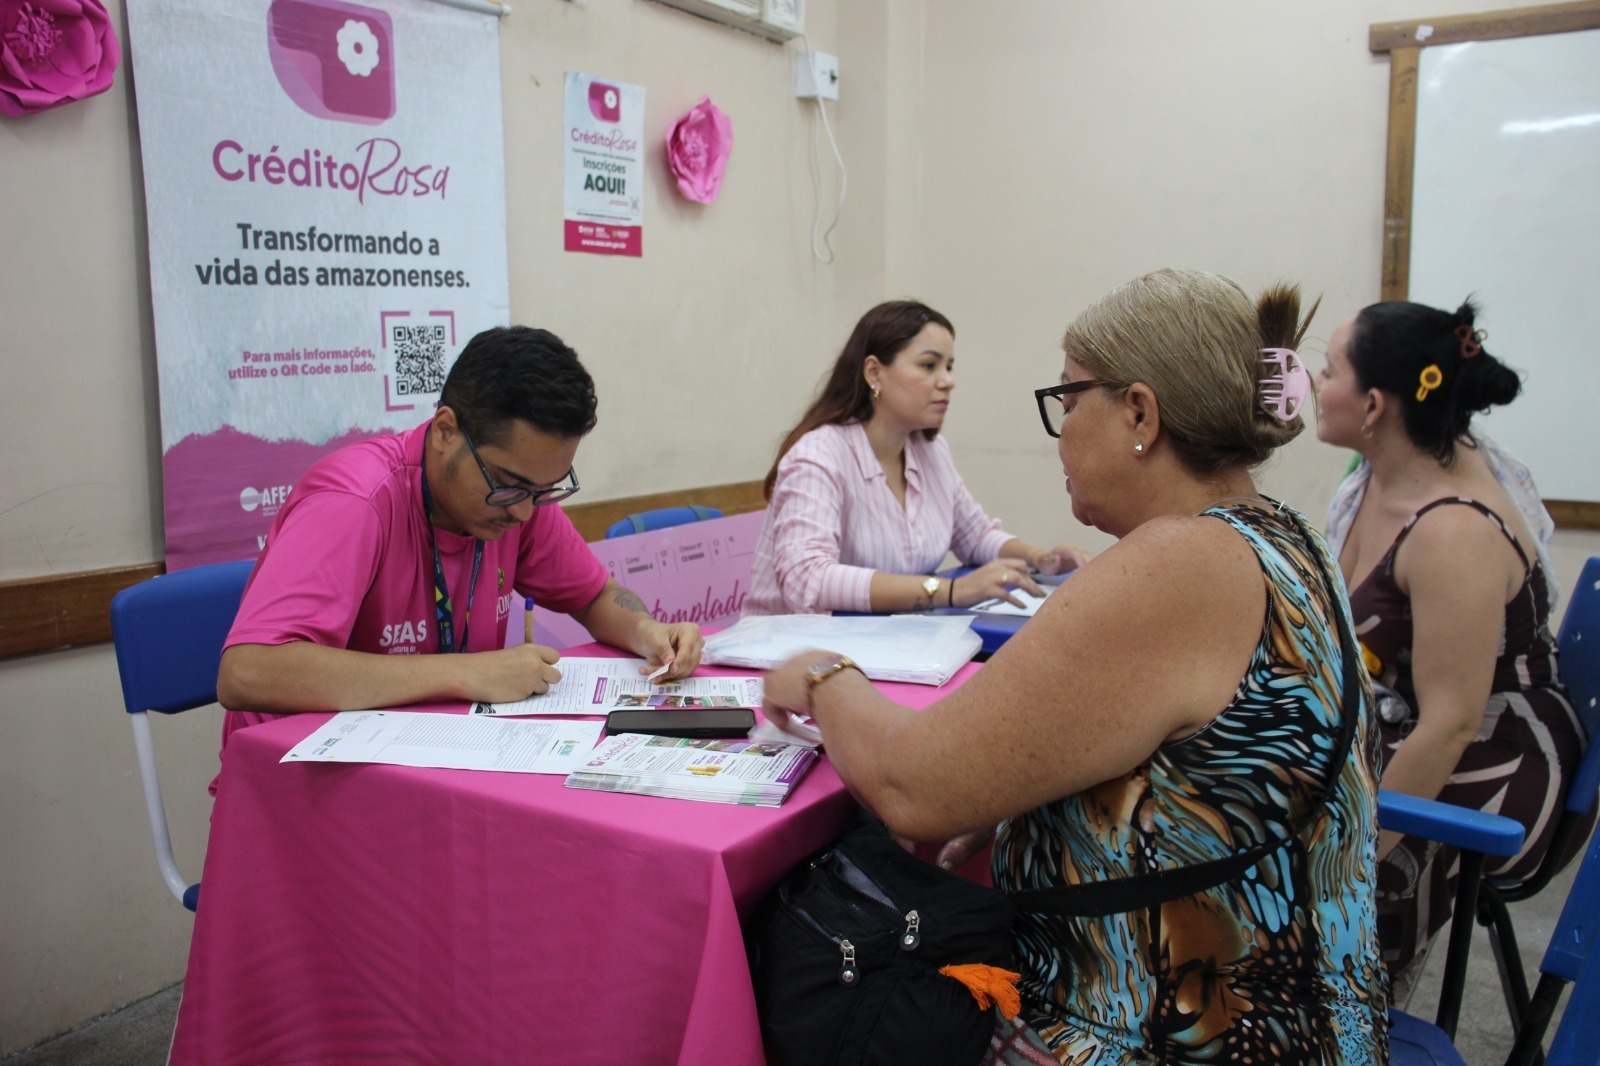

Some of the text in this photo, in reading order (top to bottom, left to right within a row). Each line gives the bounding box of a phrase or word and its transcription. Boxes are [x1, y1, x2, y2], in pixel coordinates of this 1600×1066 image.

[583, 157, 626, 177] Inscrições
[584, 173, 626, 195] AQUI!
[237, 223, 440, 256] Transformando a
[195, 258, 470, 288] vida das amazonenses.
[243, 347, 376, 363] Para mais informações,
[228, 360, 376, 380] utilize o QR Code ao lado.
[379, 619, 427, 647] SEAS
